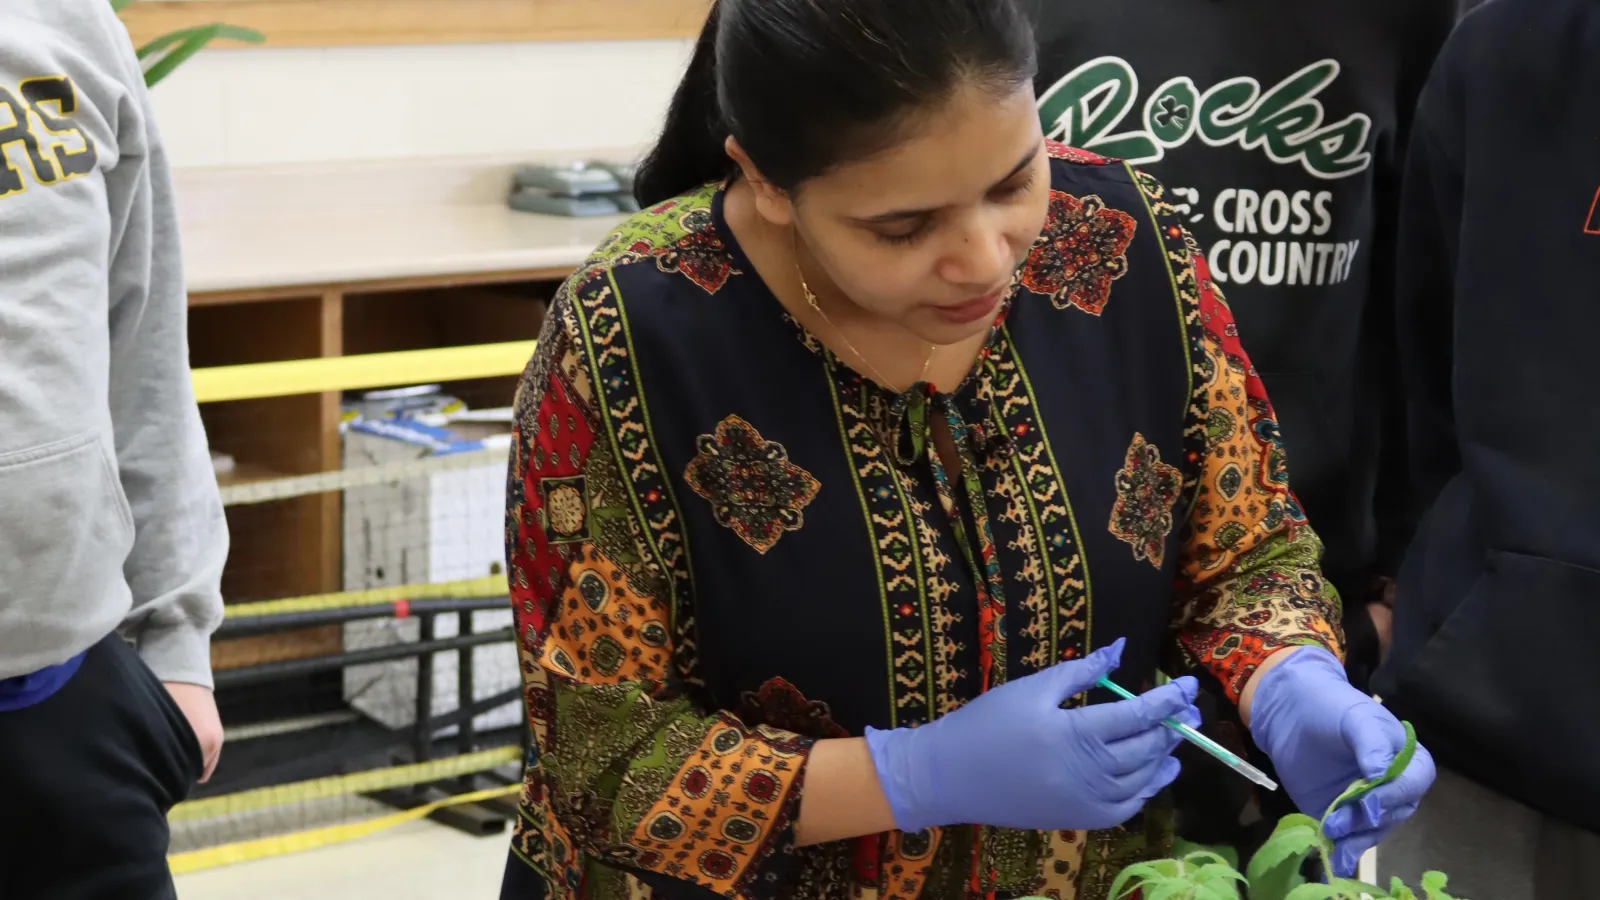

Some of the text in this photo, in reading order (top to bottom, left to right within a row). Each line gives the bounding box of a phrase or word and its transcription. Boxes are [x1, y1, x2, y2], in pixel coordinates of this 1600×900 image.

[1037, 57, 1371, 178] Rocks
[1214, 188, 1332, 235] CROSS
[1209, 240, 1359, 285] COUNTRY
